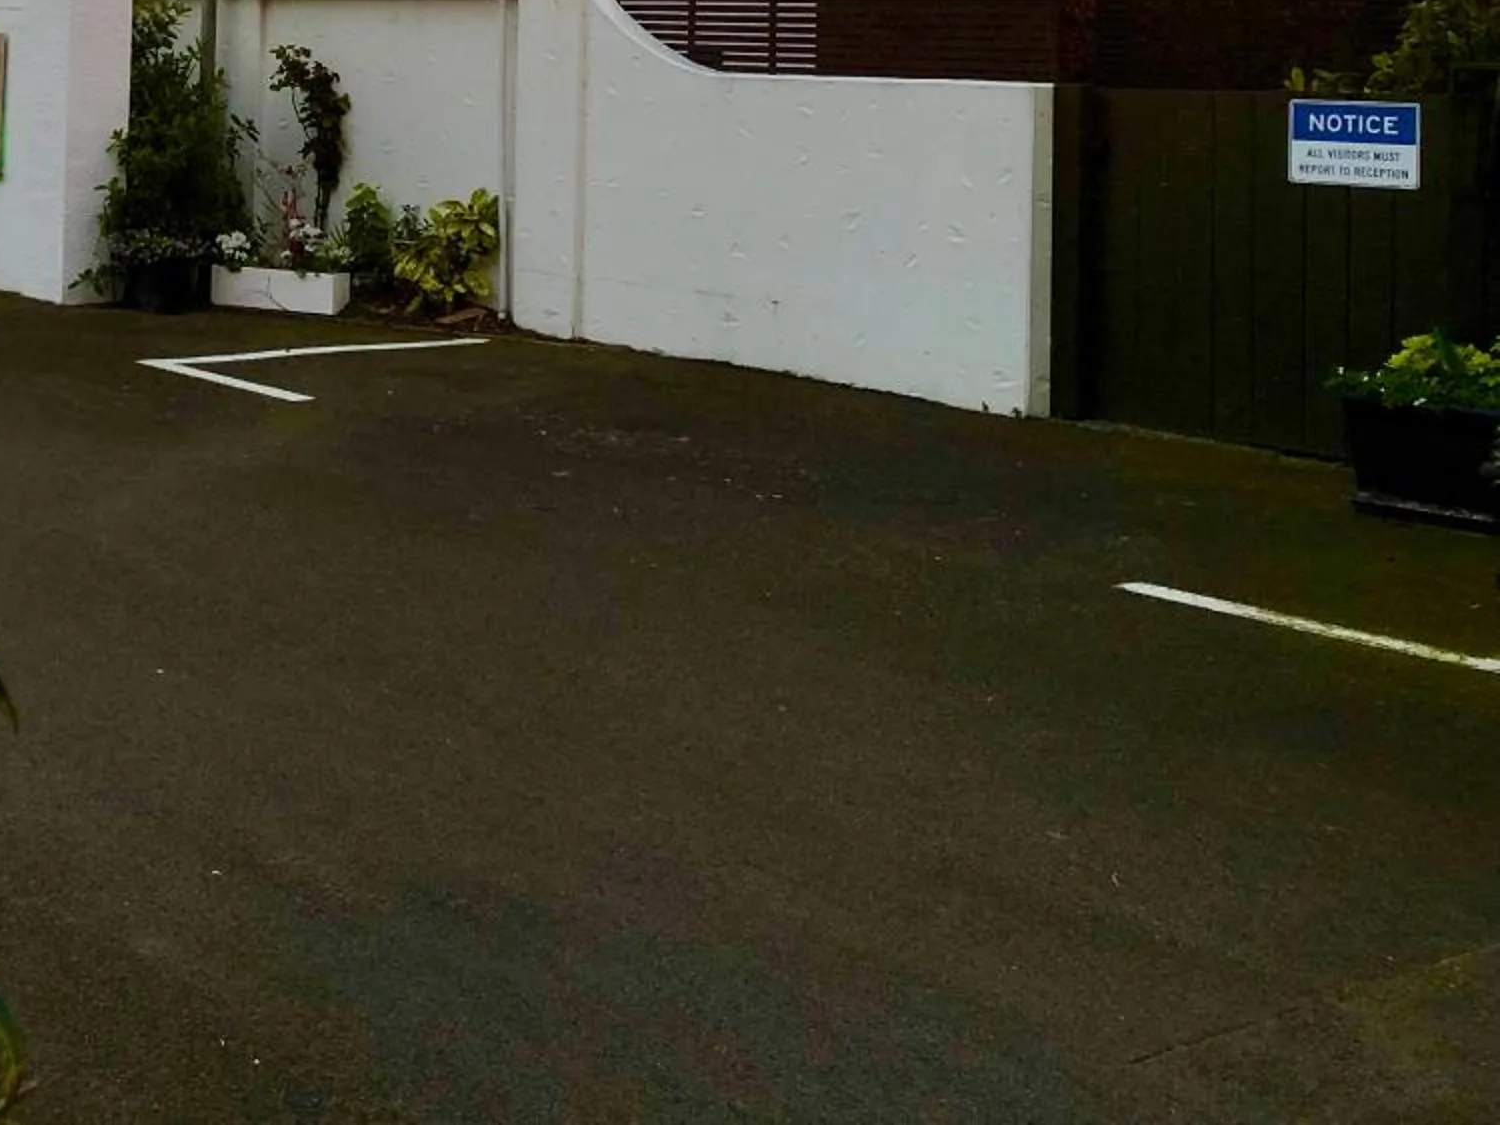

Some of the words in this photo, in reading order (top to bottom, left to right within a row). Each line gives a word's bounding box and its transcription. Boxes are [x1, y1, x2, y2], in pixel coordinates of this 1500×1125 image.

[1309, 113, 1399, 135] NOTICE
[1307, 148, 1323, 159] ALL
[1327, 149, 1371, 162] VISITORS
[1373, 151, 1401, 162] MUST
[1299, 163, 1335, 176] REPORT
[1339, 166, 1351, 176] TO
[1354, 166, 1409, 180] RECEPTION
